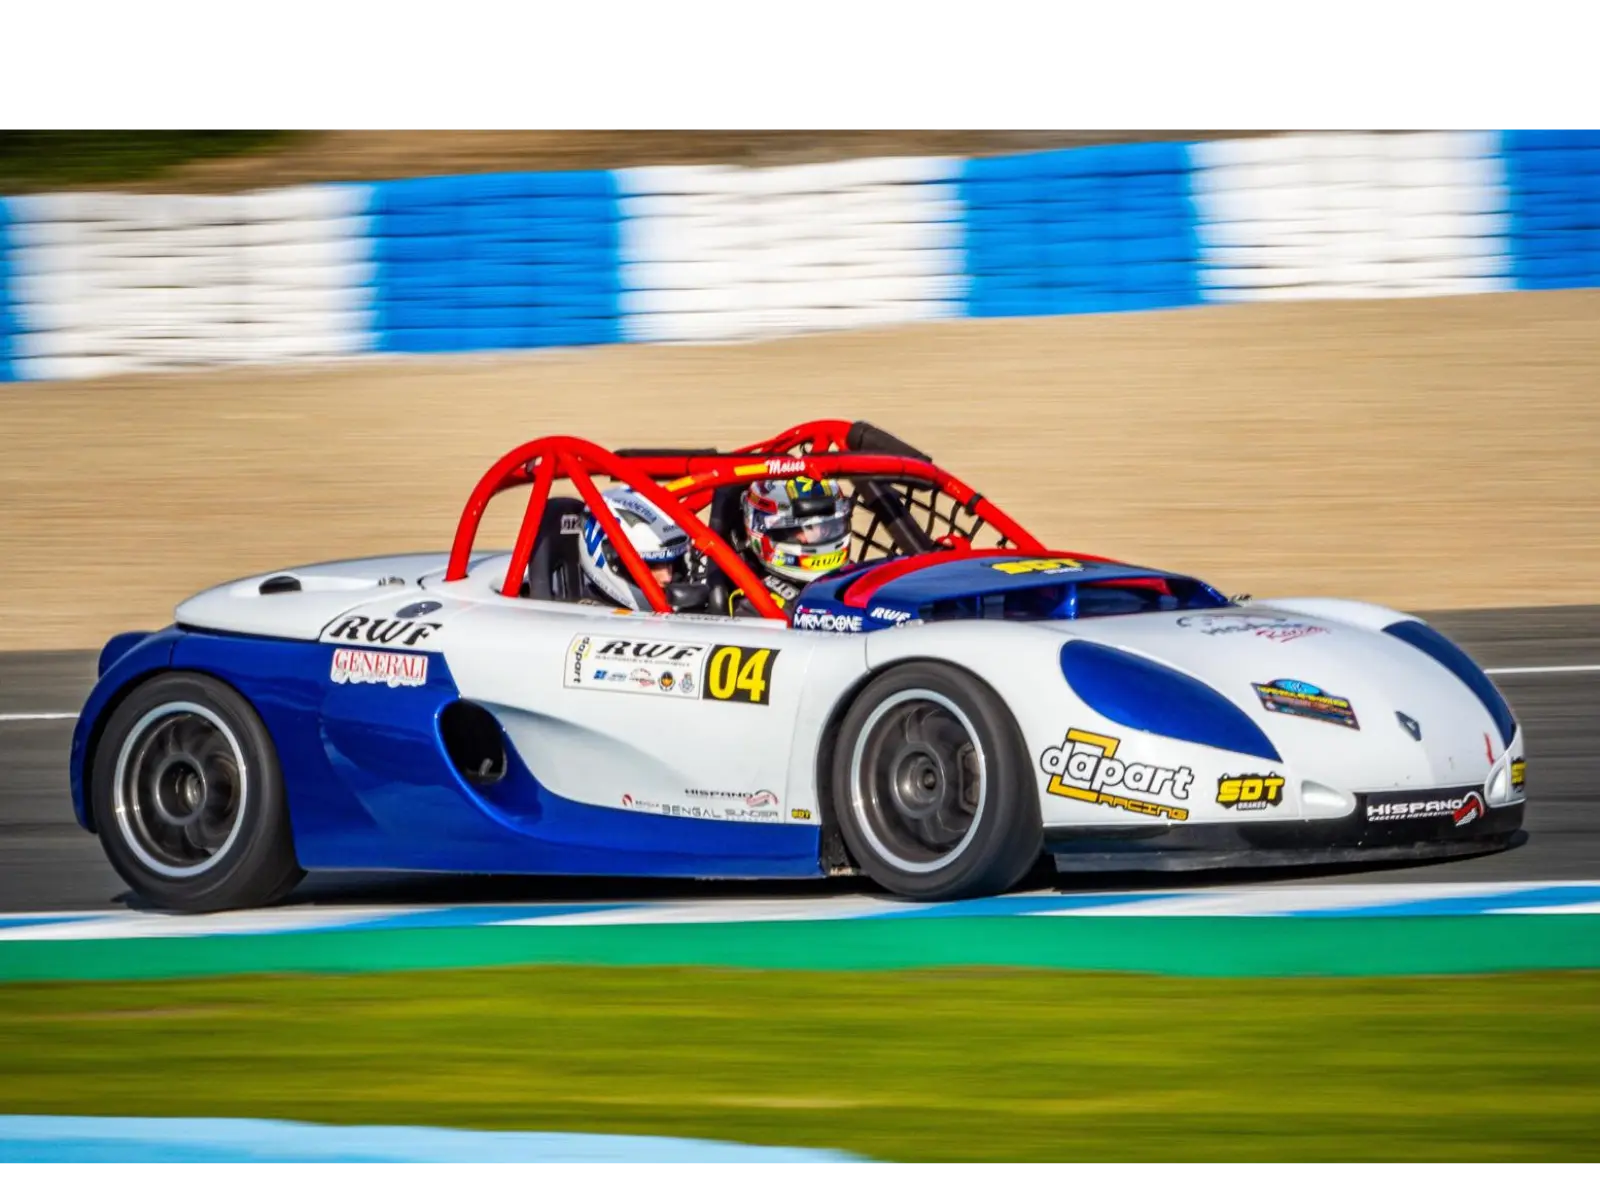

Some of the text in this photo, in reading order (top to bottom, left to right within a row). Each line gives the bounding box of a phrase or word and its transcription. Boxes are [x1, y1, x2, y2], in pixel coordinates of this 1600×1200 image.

[329, 615, 443, 646] RWF
[335, 649, 426, 681] GENERALI
[596, 640, 704, 661] RWF
[708, 646, 771, 702] 04
[1040, 740, 1195, 800] dapart
[1217, 777, 1285, 803] SDT
[1367, 799, 1464, 817] HISPANO
